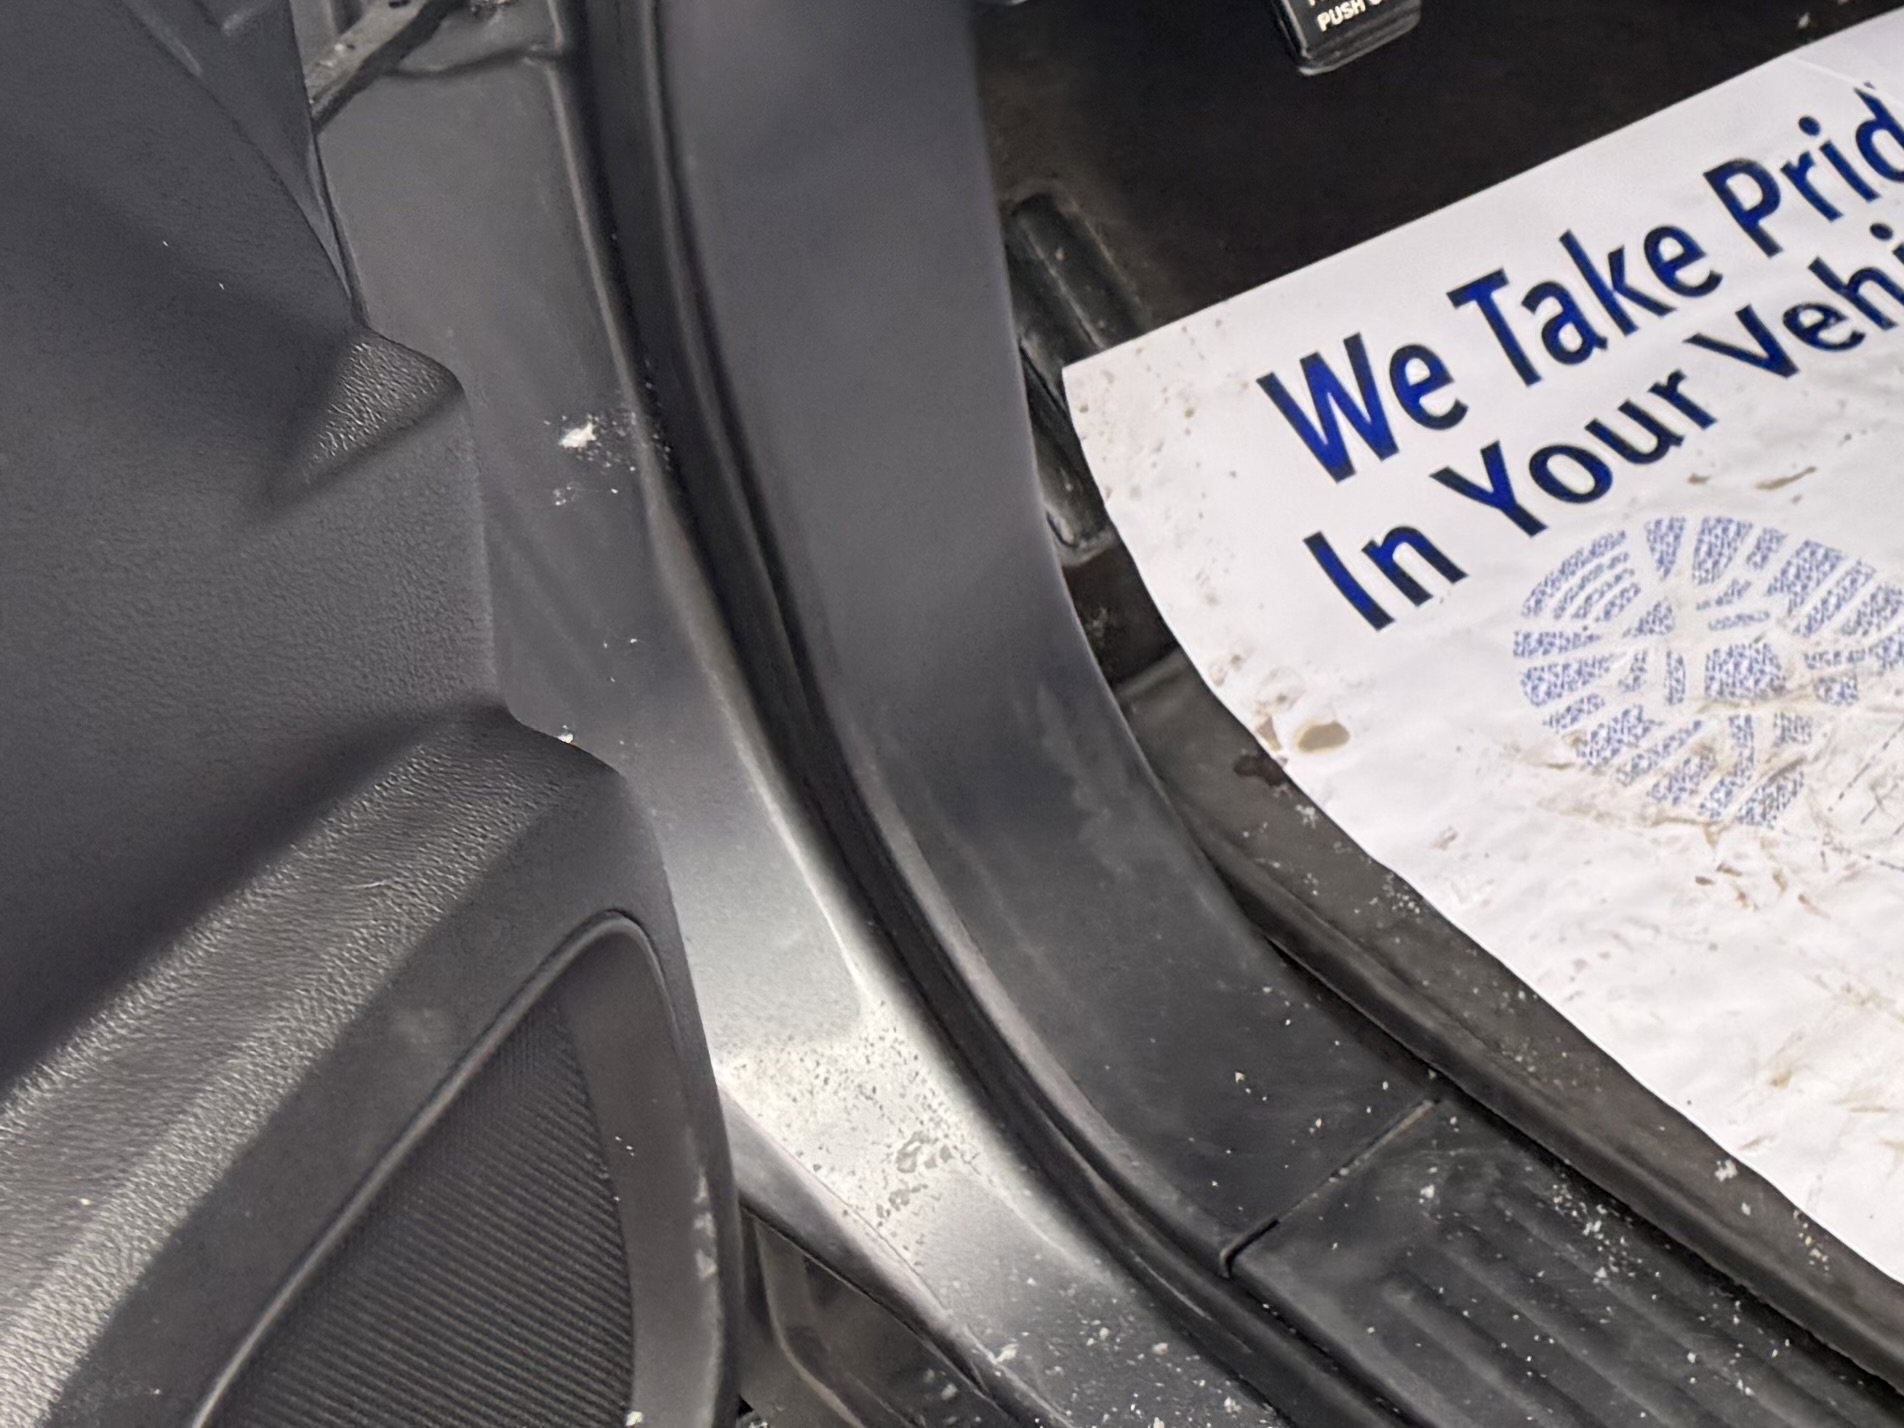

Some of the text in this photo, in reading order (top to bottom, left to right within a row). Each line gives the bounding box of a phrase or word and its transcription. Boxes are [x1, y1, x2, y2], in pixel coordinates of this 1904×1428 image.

[1255, 331, 1469, 483] We
[1445, 228, 1724, 388] Take
[1301, 524, 1470, 632] In
[1428, 368, 1718, 538] Your
